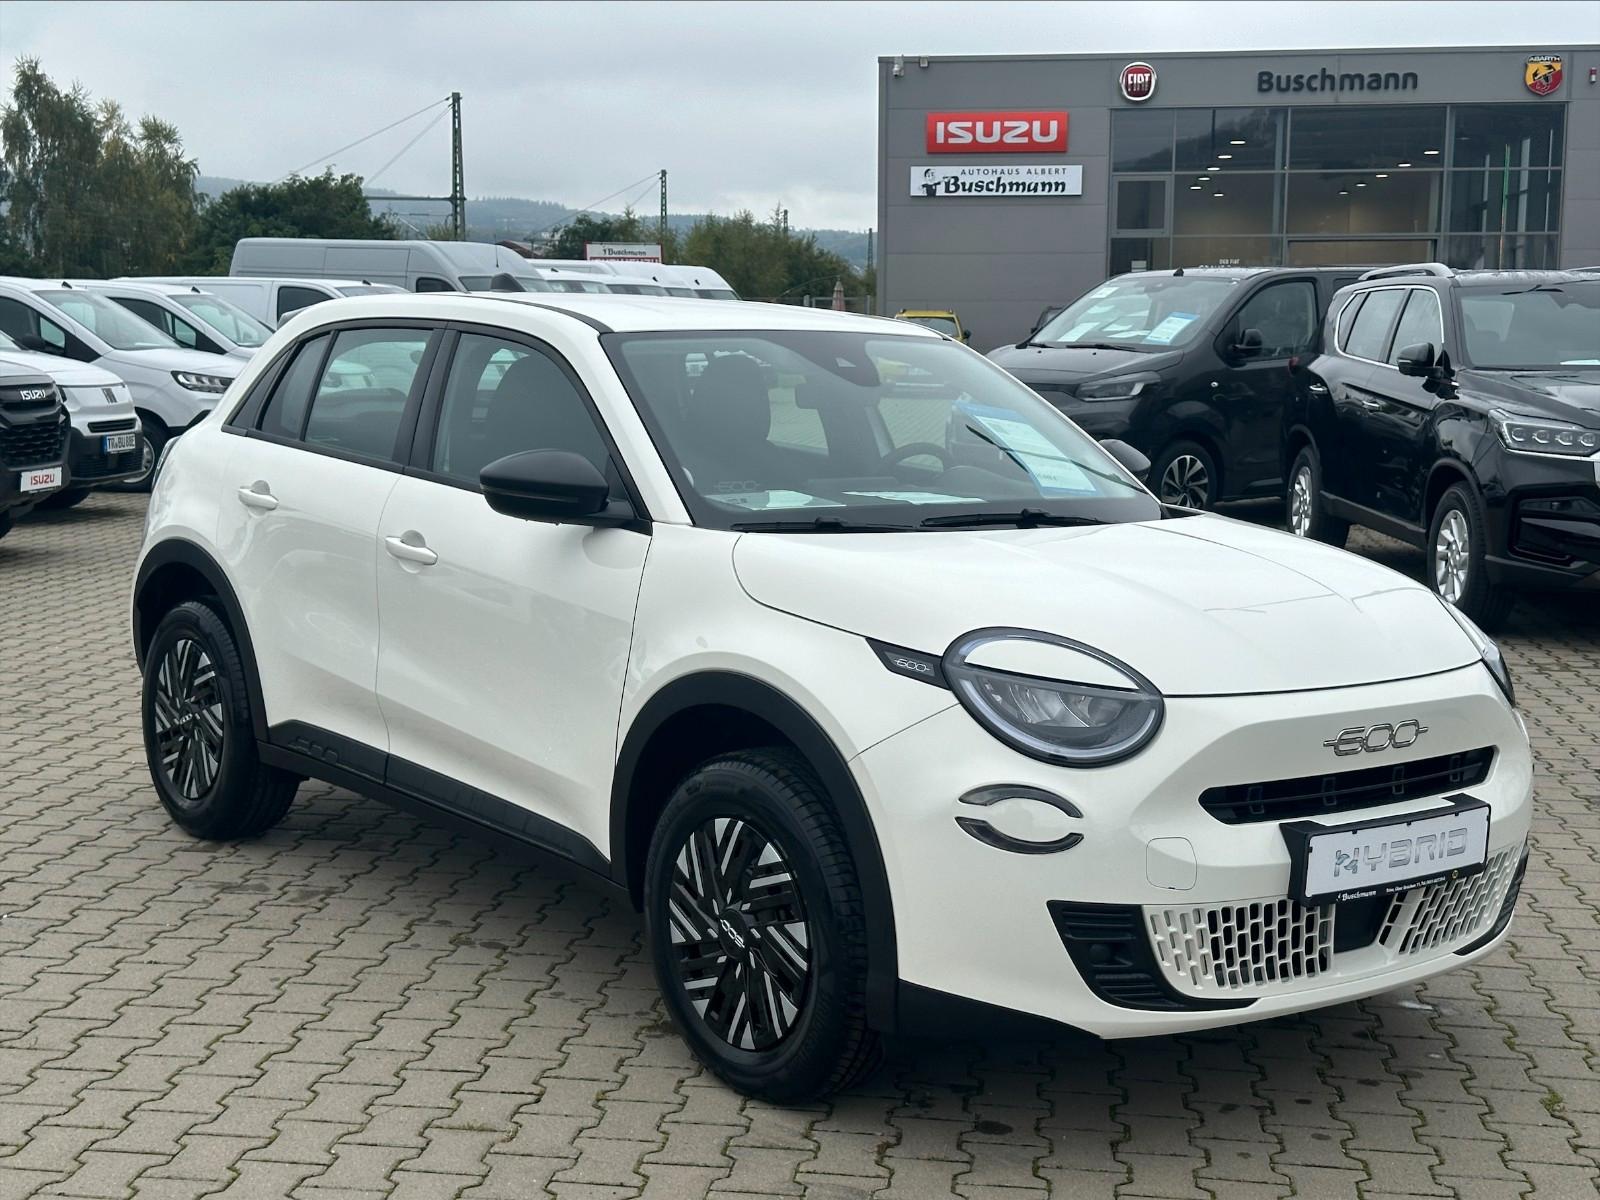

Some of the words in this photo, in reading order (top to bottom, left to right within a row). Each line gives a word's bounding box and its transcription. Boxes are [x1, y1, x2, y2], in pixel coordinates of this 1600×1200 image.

[1127, 73, 1151, 91] FIAT
[1257, 67, 1418, 93] Buschmann
[936, 120, 1058, 144] ISUZU
[960, 168, 1021, 176] AUTOHAUS
[1026, 167, 1067, 176] ALBERT
[943, 175, 1066, 194] Buschmann
[20, 389, 46, 400] ISUZU
[30, 473, 55, 486] ISUZU
[897, 658, 927, 672] 600
[1333, 719, 1420, 756] 600
[1333, 828, 1468, 878] HYBRID
